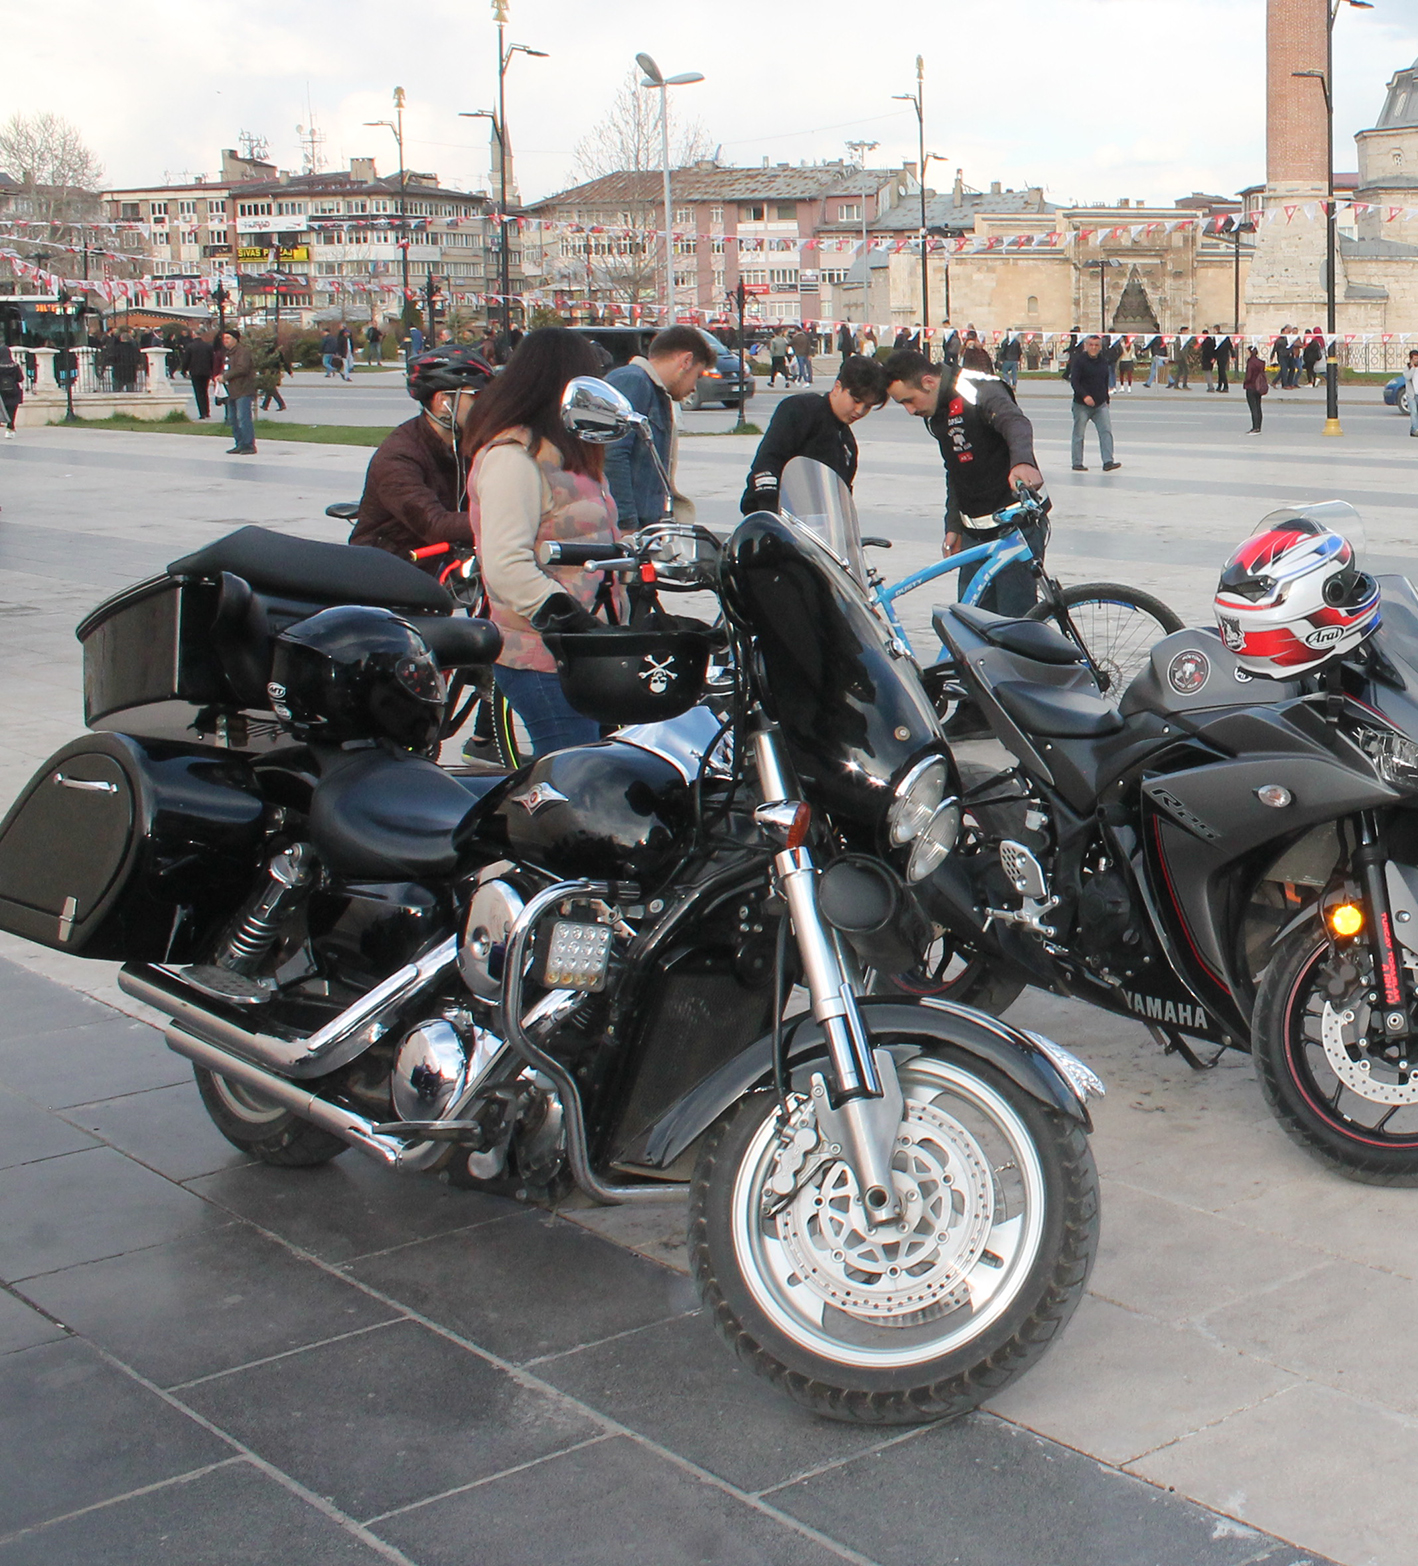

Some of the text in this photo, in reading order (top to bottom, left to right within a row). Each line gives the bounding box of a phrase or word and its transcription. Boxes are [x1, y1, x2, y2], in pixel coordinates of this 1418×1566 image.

[894, 578, 923, 596] DUSTY
[1313, 627, 1341, 645] Arai
[1122, 988, 1208, 1030] YAMAHA
